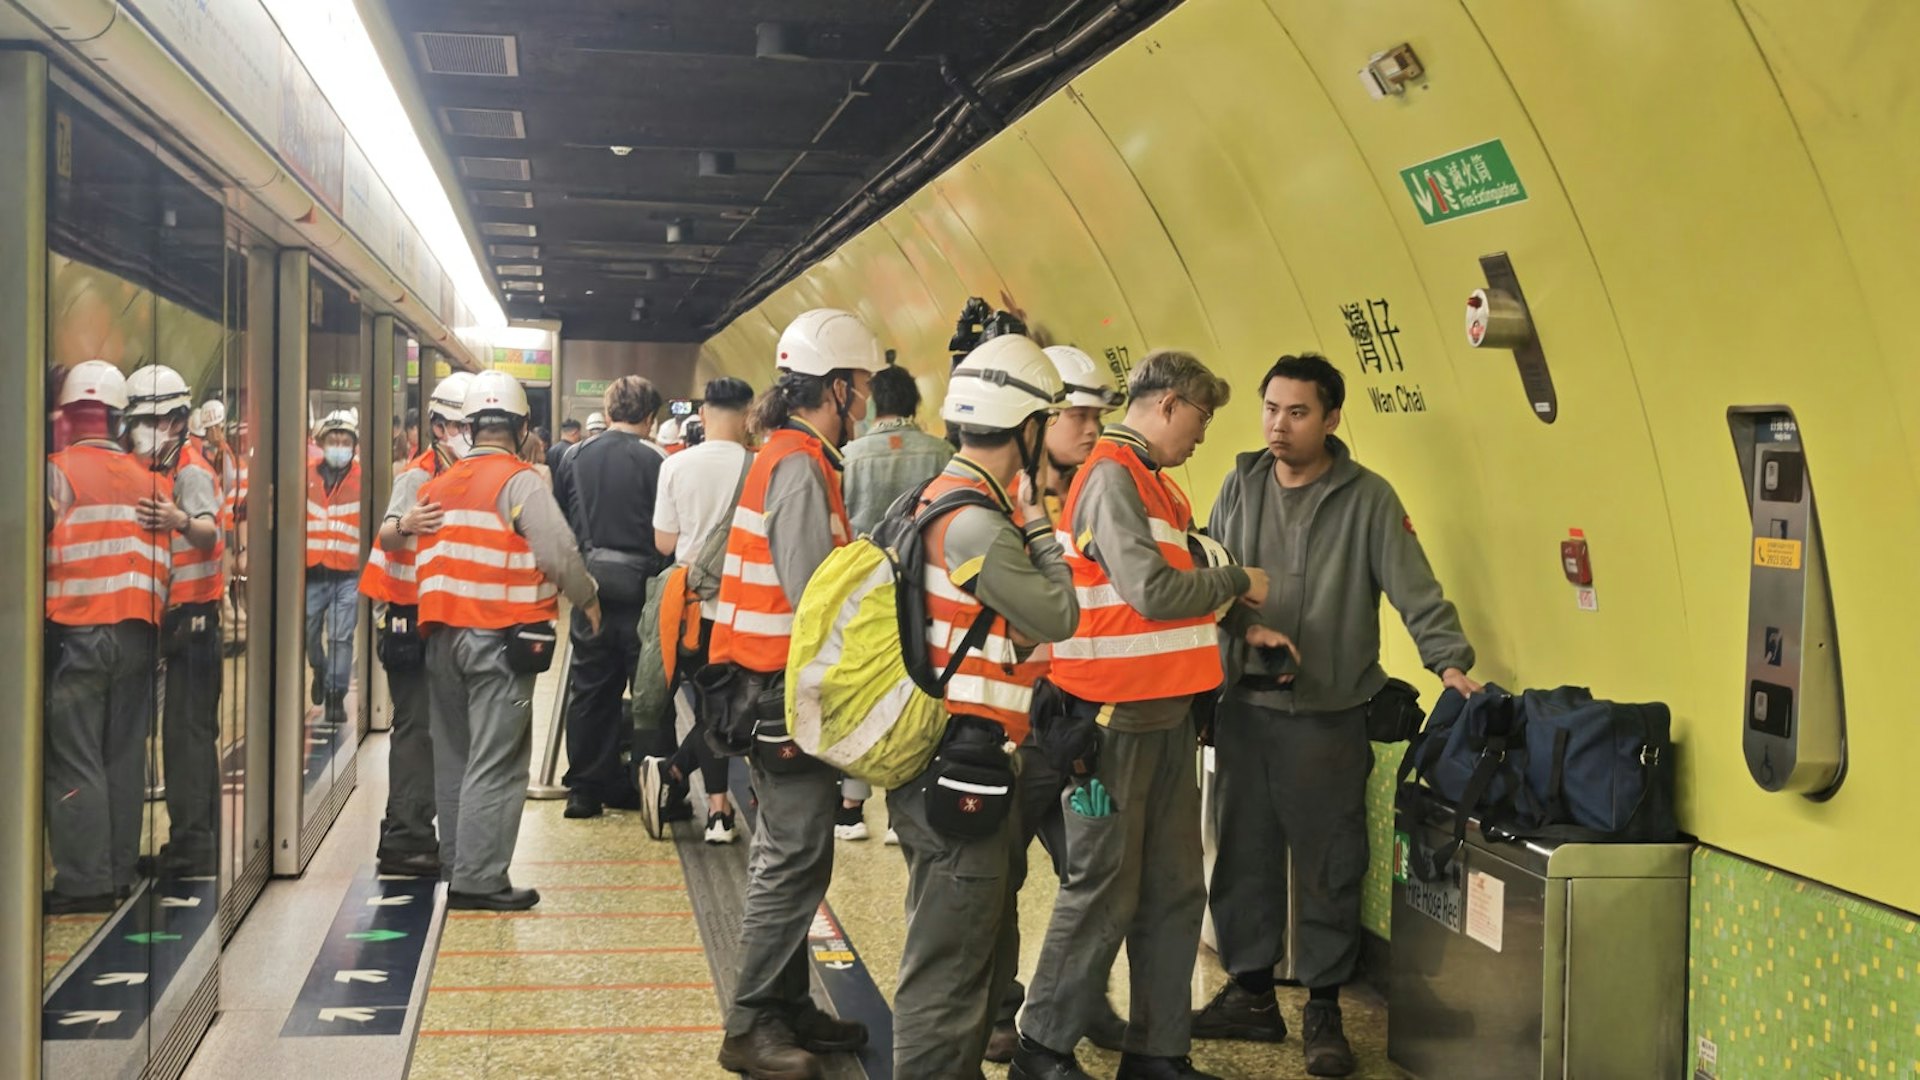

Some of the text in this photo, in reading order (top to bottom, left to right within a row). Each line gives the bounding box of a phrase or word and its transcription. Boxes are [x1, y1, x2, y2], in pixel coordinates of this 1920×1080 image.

[1339, 298, 1404, 374] 灣仔
[1368, 384, 1427, 413] Wan Chai
[1422, 880, 1441, 920] Hose
[1442, 891, 1461, 932] Reel
